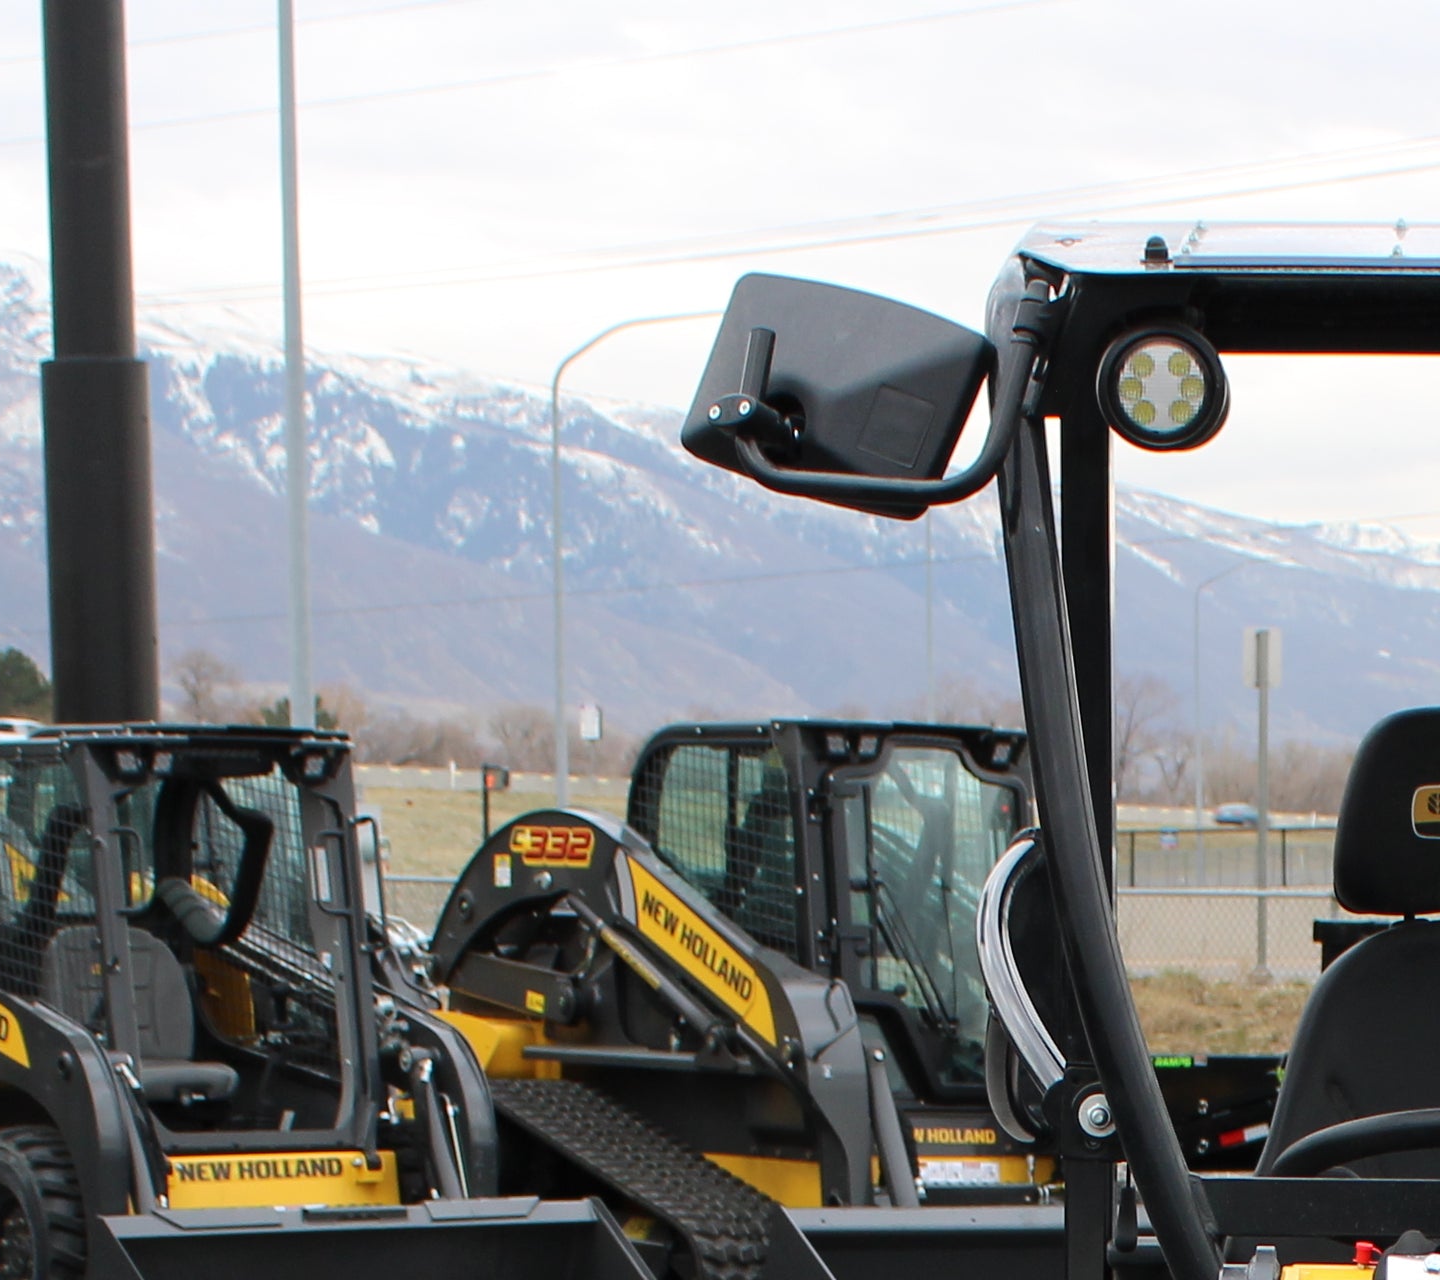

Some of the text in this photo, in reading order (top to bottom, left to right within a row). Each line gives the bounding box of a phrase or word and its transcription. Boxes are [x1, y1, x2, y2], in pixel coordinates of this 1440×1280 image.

[511, 827, 591, 861] C332
[642, 890, 753, 1002] NEW HOLLAND
[926, 1128, 997, 1145] HOLLAND
[178, 1157, 344, 1182] NEW HOLLAND
